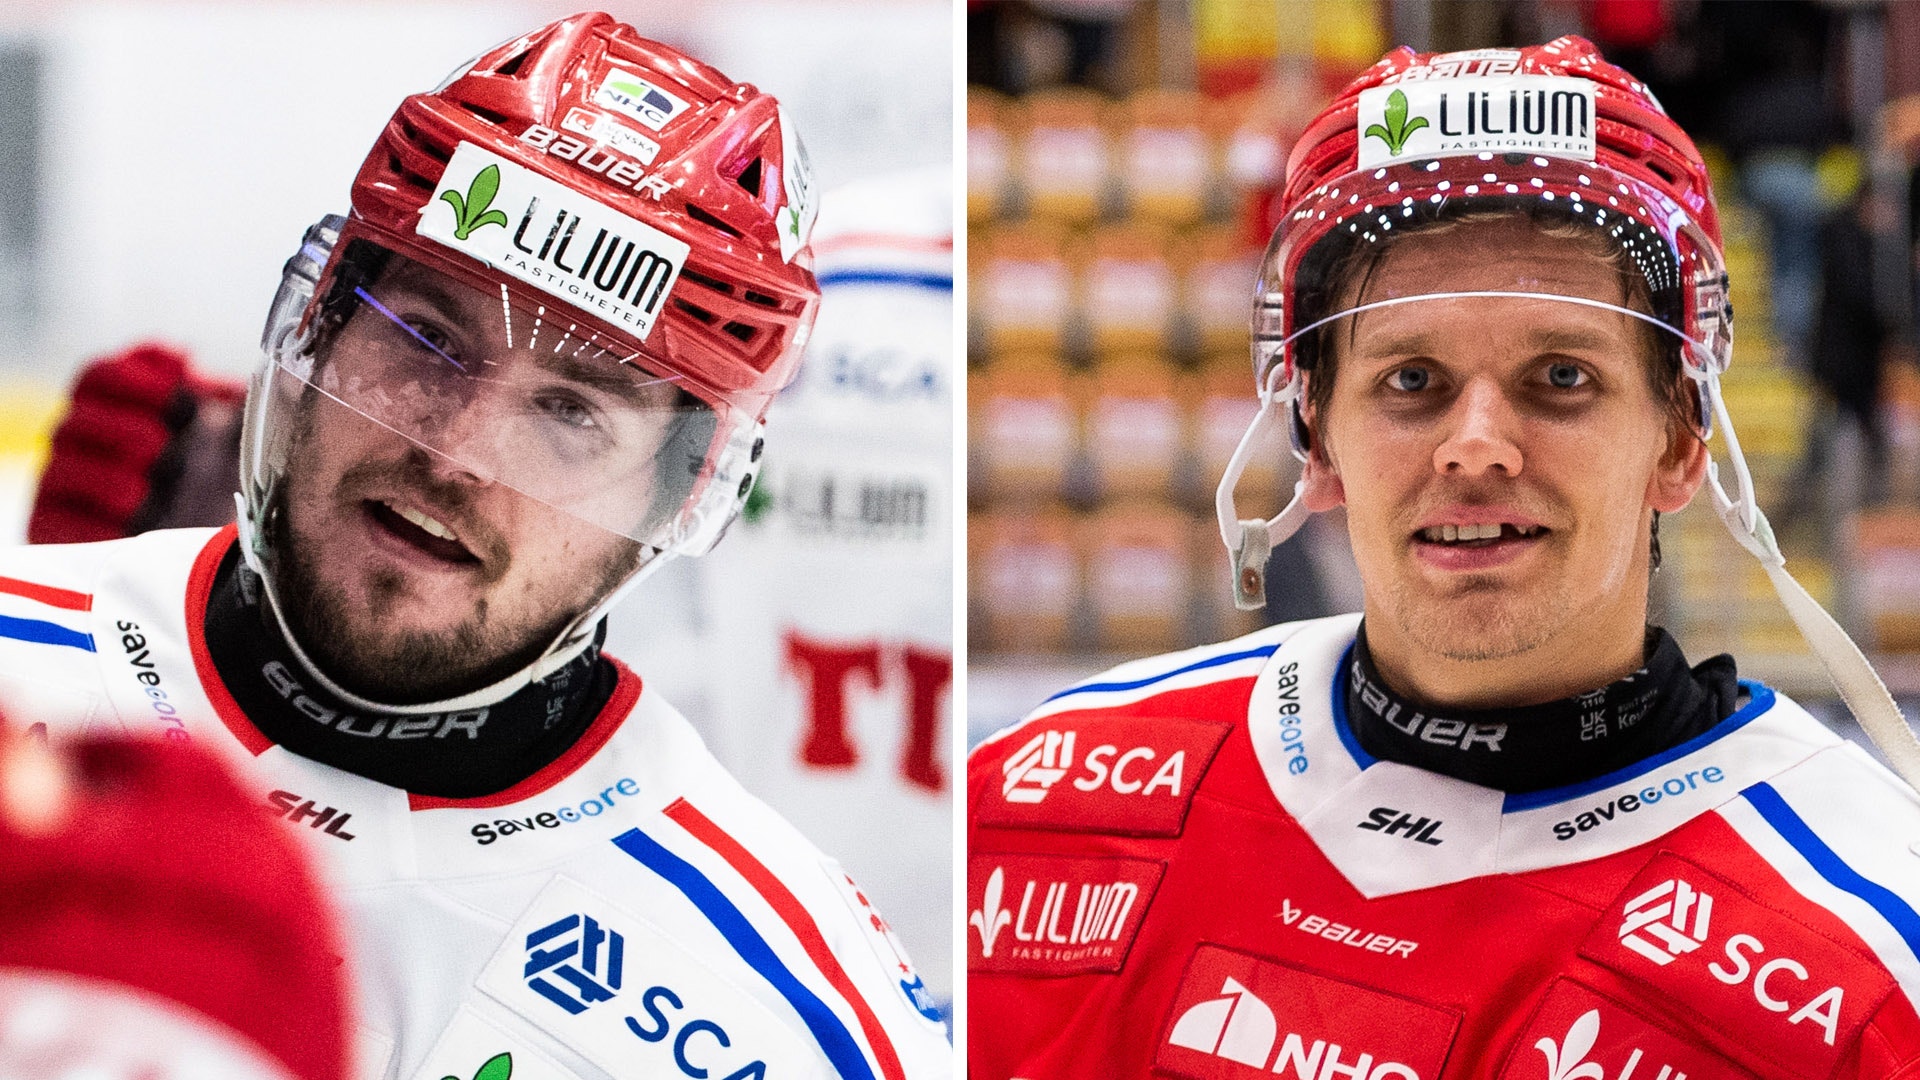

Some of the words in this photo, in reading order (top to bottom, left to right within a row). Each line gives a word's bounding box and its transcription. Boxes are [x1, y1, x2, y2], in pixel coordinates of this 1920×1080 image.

[603, 89, 665, 123] NHC
[1440, 90, 1587, 138] LILIUM
[1441, 139, 1588, 151] FASTIGHETER
[513, 196, 673, 315] LILIUM
[504, 253, 646, 330] FASTIGHETER
[117, 620, 191, 742] savecore
[1278, 662, 1309, 775] savecore
[1073, 744, 1185, 797] SCA
[264, 790, 356, 842] SHL
[471, 778, 640, 846] savecore
[1357, 807, 1444, 847] SHL
[1553, 766, 1725, 841] savecore
[1015, 881, 1138, 944] LILIUM
[1708, 934, 1845, 1046] SCA
